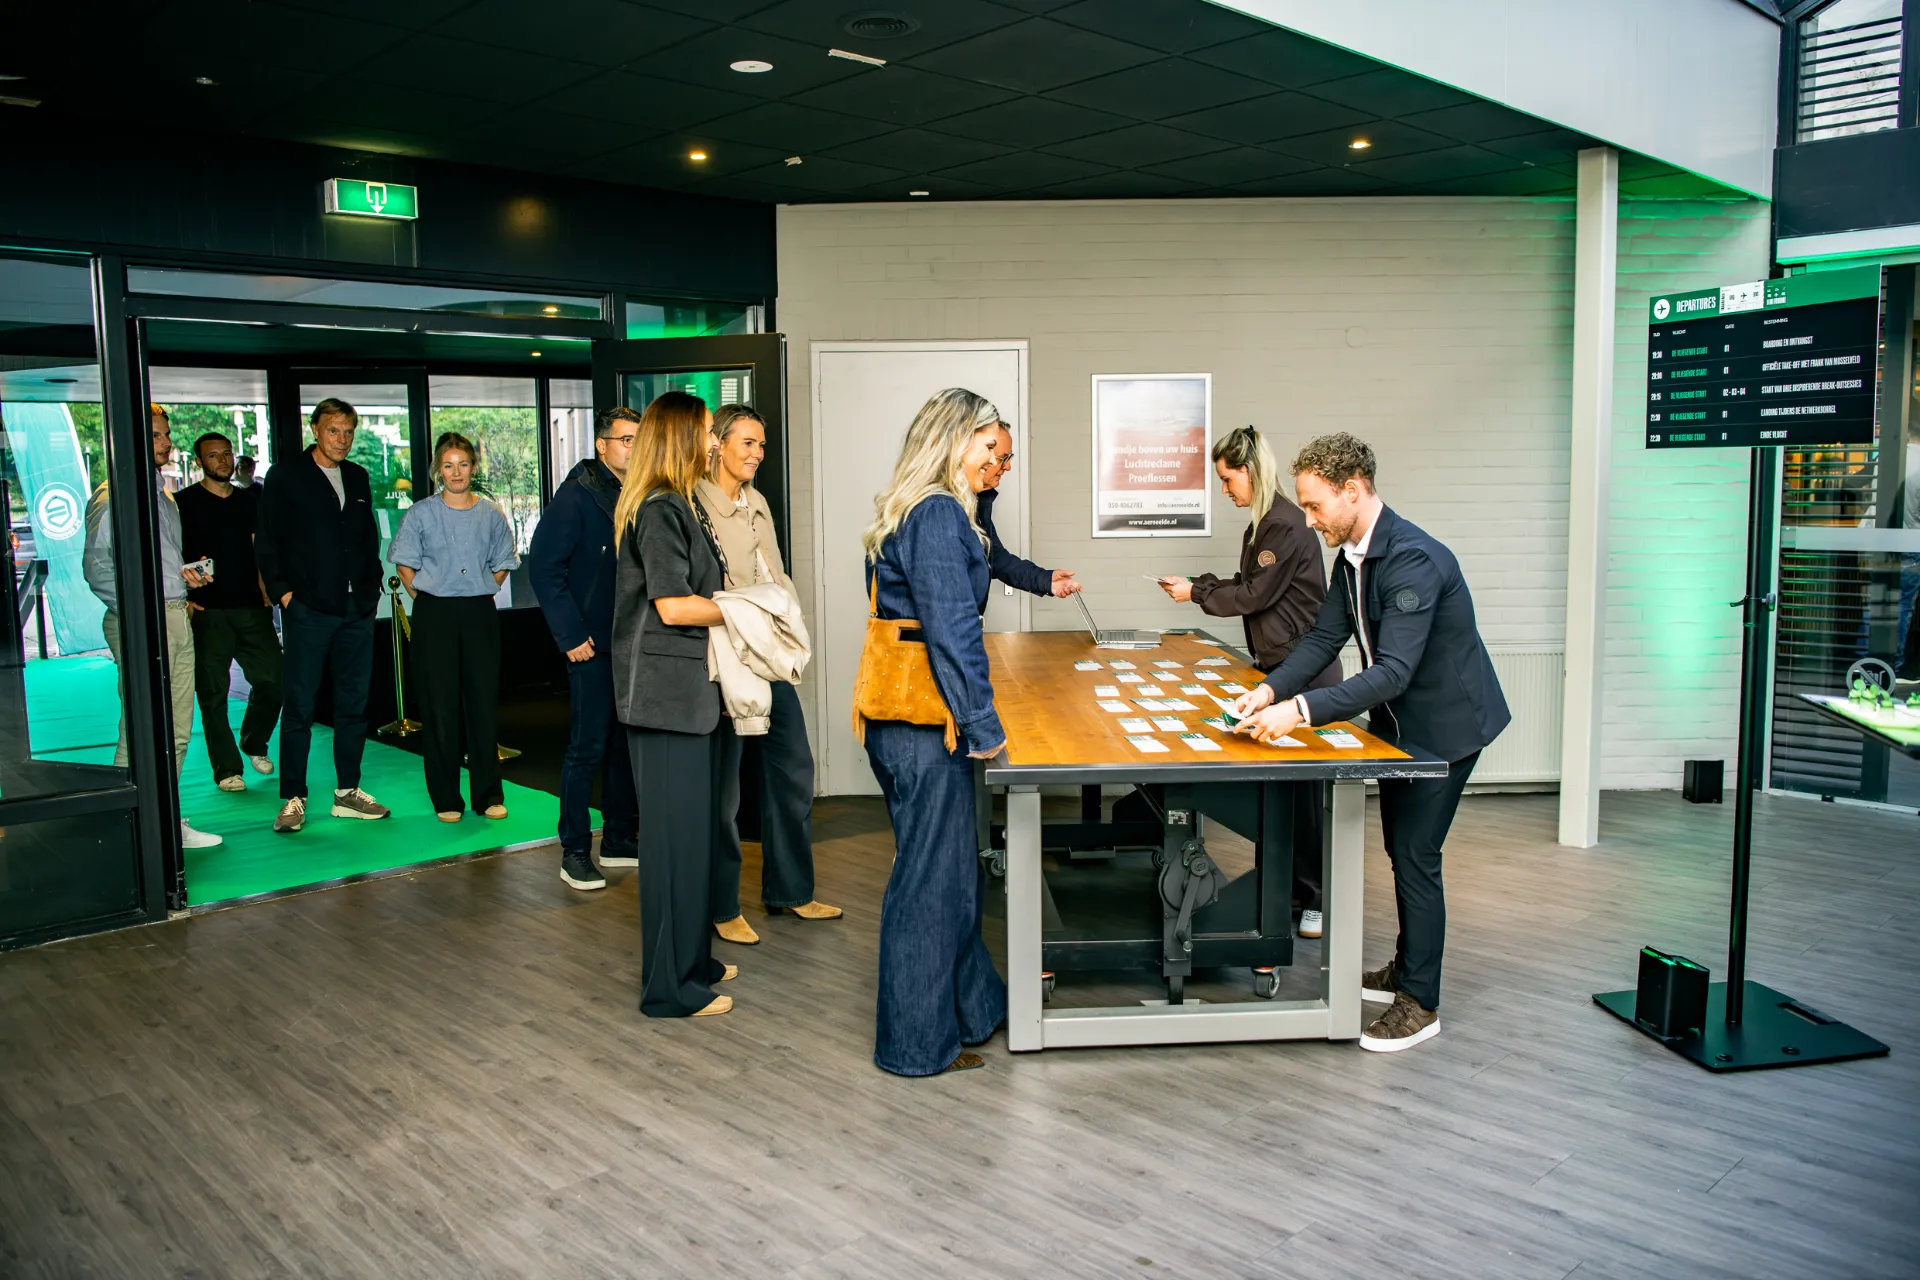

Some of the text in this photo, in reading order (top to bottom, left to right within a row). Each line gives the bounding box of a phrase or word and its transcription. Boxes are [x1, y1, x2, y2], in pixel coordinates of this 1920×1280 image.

[1676, 296, 1716, 313] DEPARTURES
[1784, 338, 1788, 346] EN
[1782, 360, 1800, 369] TAKE-OFF
[1801, 360, 1810, 368] MET
[1810, 359, 1824, 367] FRANK
[1825, 358, 1833, 366] VAN
[1695, 390, 1707, 398] START
[1762, 386, 1774, 394] START
[1774, 385, 1782, 393] VAN
[1796, 407, 1801, 415] DE
[1760, 430, 1788, 439] EINDE VLUCHT
[1139, 445, 1164, 454] boven
[1166, 446, 1178, 454] uw
[1180, 444, 1198, 454] huis
[1124, 459, 1181, 469] Luchtreclame
[1128, 473, 1177, 483] Proeflessen
